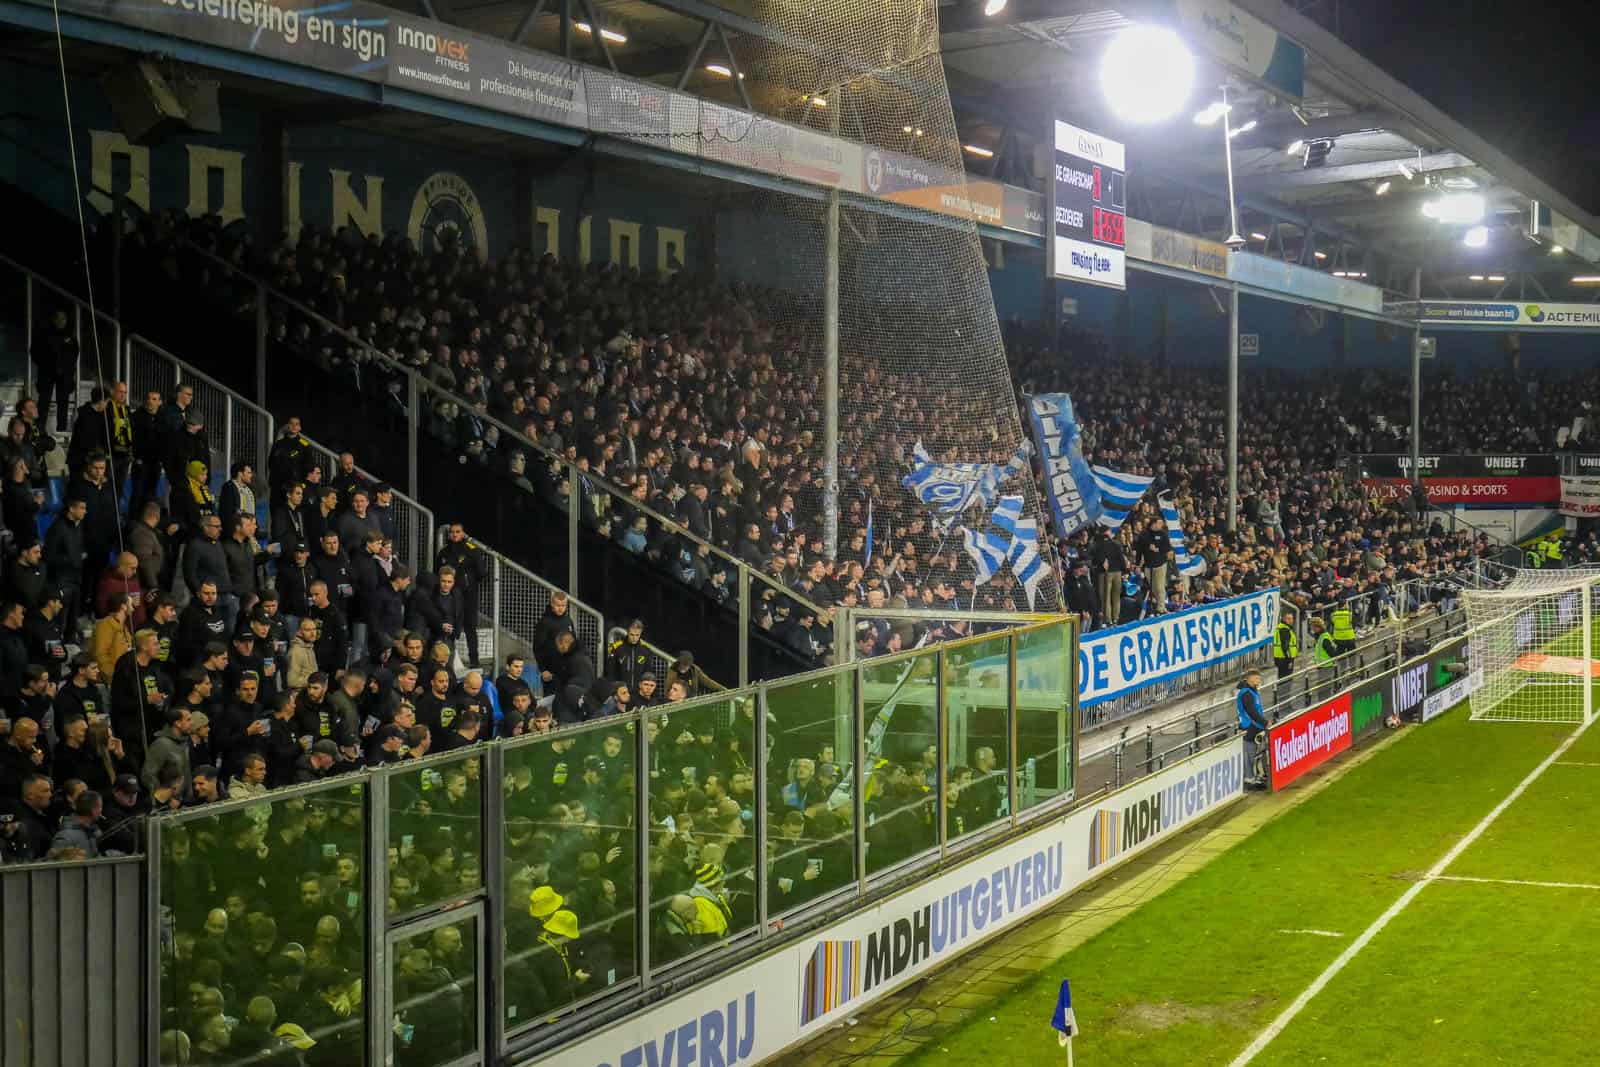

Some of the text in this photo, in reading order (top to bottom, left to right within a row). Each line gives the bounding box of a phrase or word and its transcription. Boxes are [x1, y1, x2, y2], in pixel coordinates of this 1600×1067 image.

[306, 16, 335, 45] en
[342, 19, 386, 61] sign
[398, 25, 470, 60] innovex
[435, 56, 470, 73] FITNESS
[521, 63, 563, 88] leverancier
[398, 64, 471, 92] www.innovexfitness.nl
[480, 77, 534, 102] professionele
[1055, 163, 1063, 181] DE
[1063, 166, 1094, 192] GRAAFSCHAP
[1055, 206, 1084, 228] BEZOEKERS
[1397, 456, 1441, 469] UNBET
[1485, 456, 1527, 469] UNIBET
[1461, 484, 1470, 496] &
[1472, 484, 1508, 496] SPORTS
[1120, 603, 1262, 682] GRAAFSCHAP
[1392, 663, 1429, 714] UNIBET
[1274, 728, 1308, 773] Keuken
[1308, 708, 1349, 753] Kampioen
